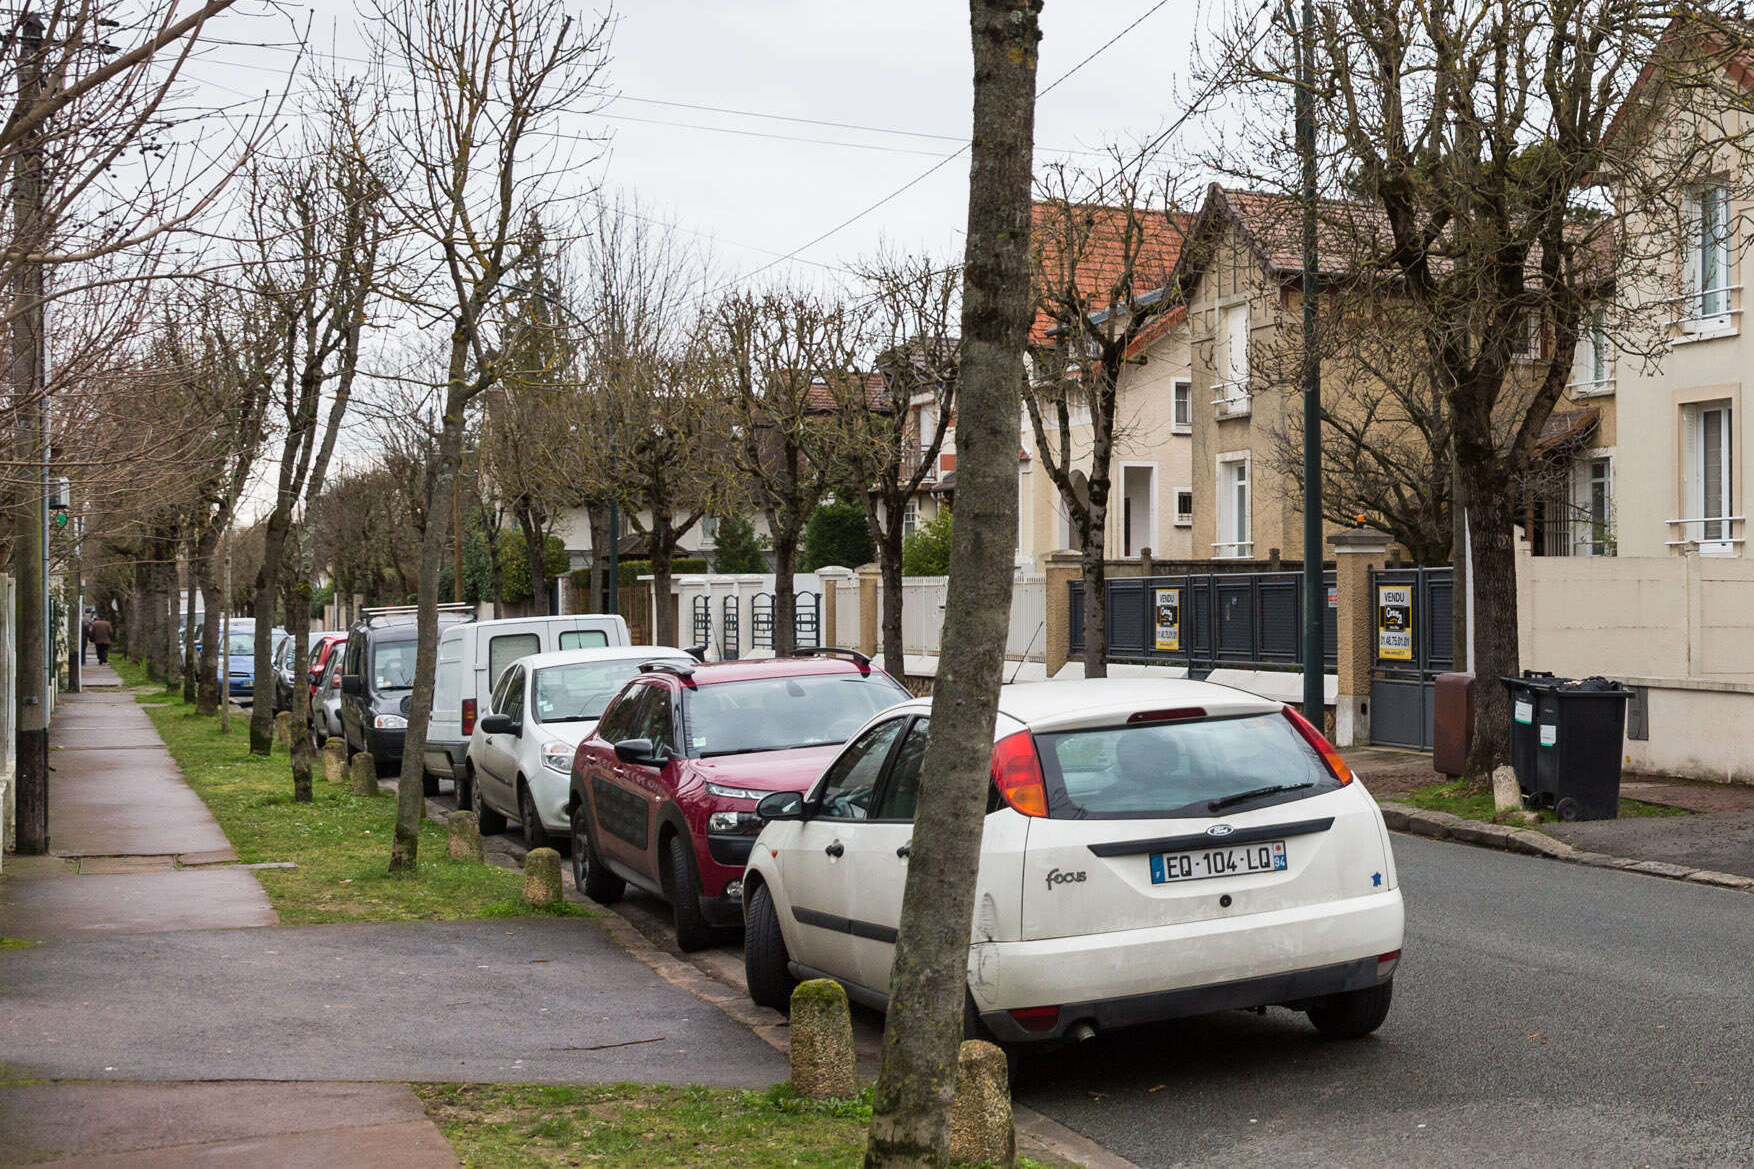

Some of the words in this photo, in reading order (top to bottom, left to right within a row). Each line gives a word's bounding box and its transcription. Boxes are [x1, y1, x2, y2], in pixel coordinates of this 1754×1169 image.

[1160, 594, 1175, 603] VENDU
[1384, 592, 1405, 603] VENDU
[1274, 855, 1286, 867] 94
